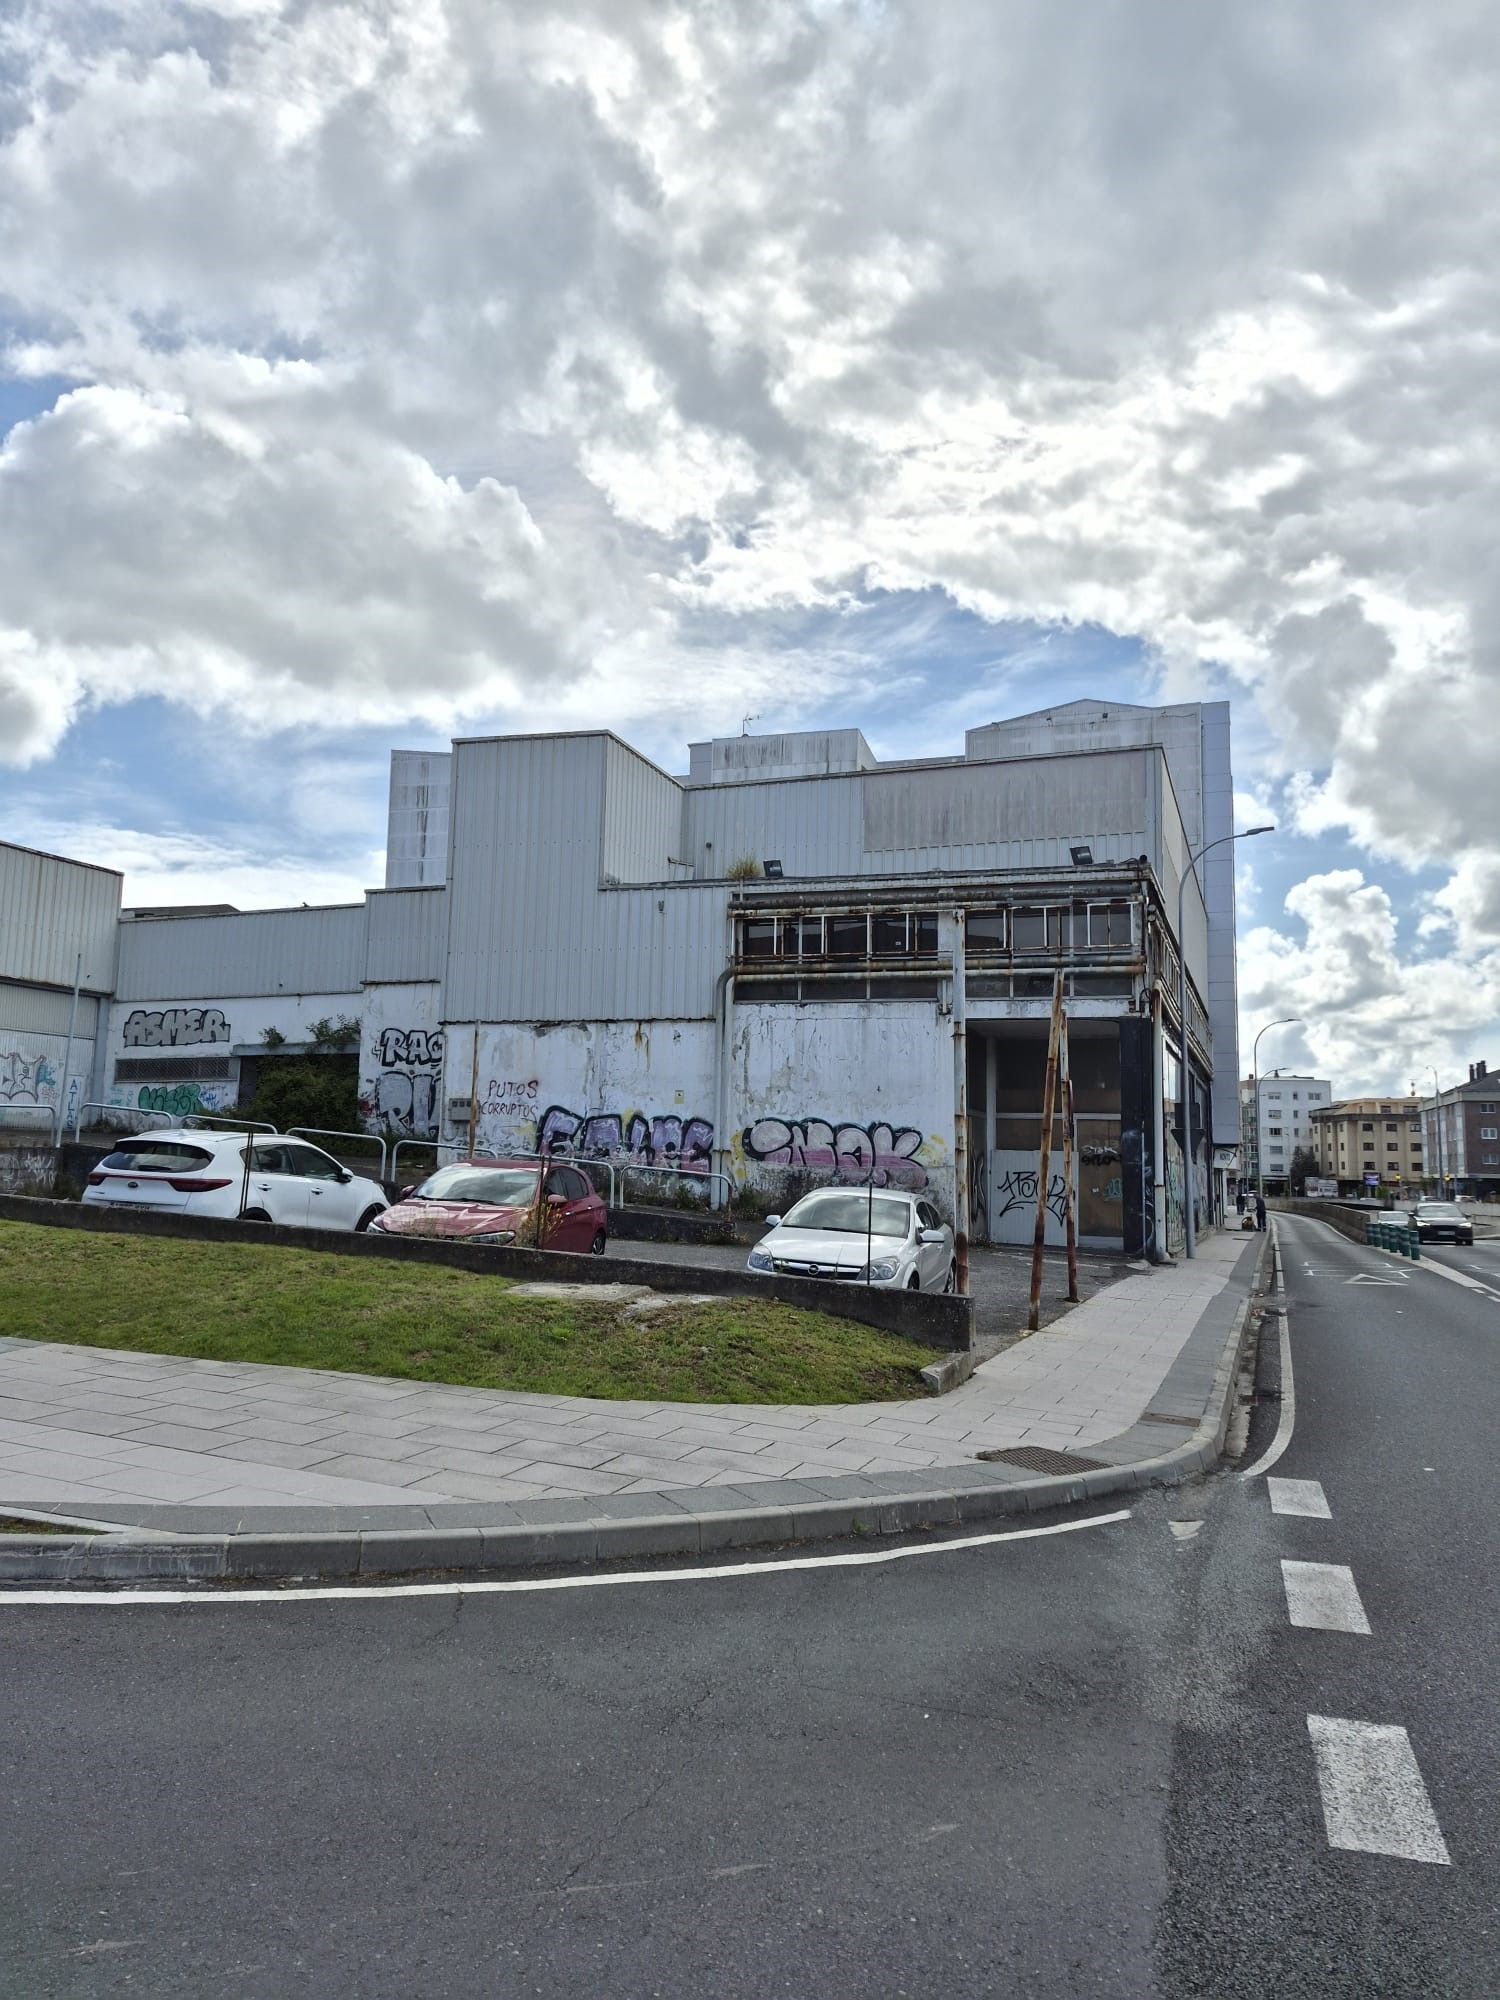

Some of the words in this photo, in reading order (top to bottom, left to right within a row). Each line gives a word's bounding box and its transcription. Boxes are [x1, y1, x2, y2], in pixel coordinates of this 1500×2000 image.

[123, 1008, 231, 1048] ASMER
[67, 1079, 78, 1129] ATLAS
[488, 1079, 539, 1099] PUTOS
[480, 1101, 538, 1124] CORRUPTOS
